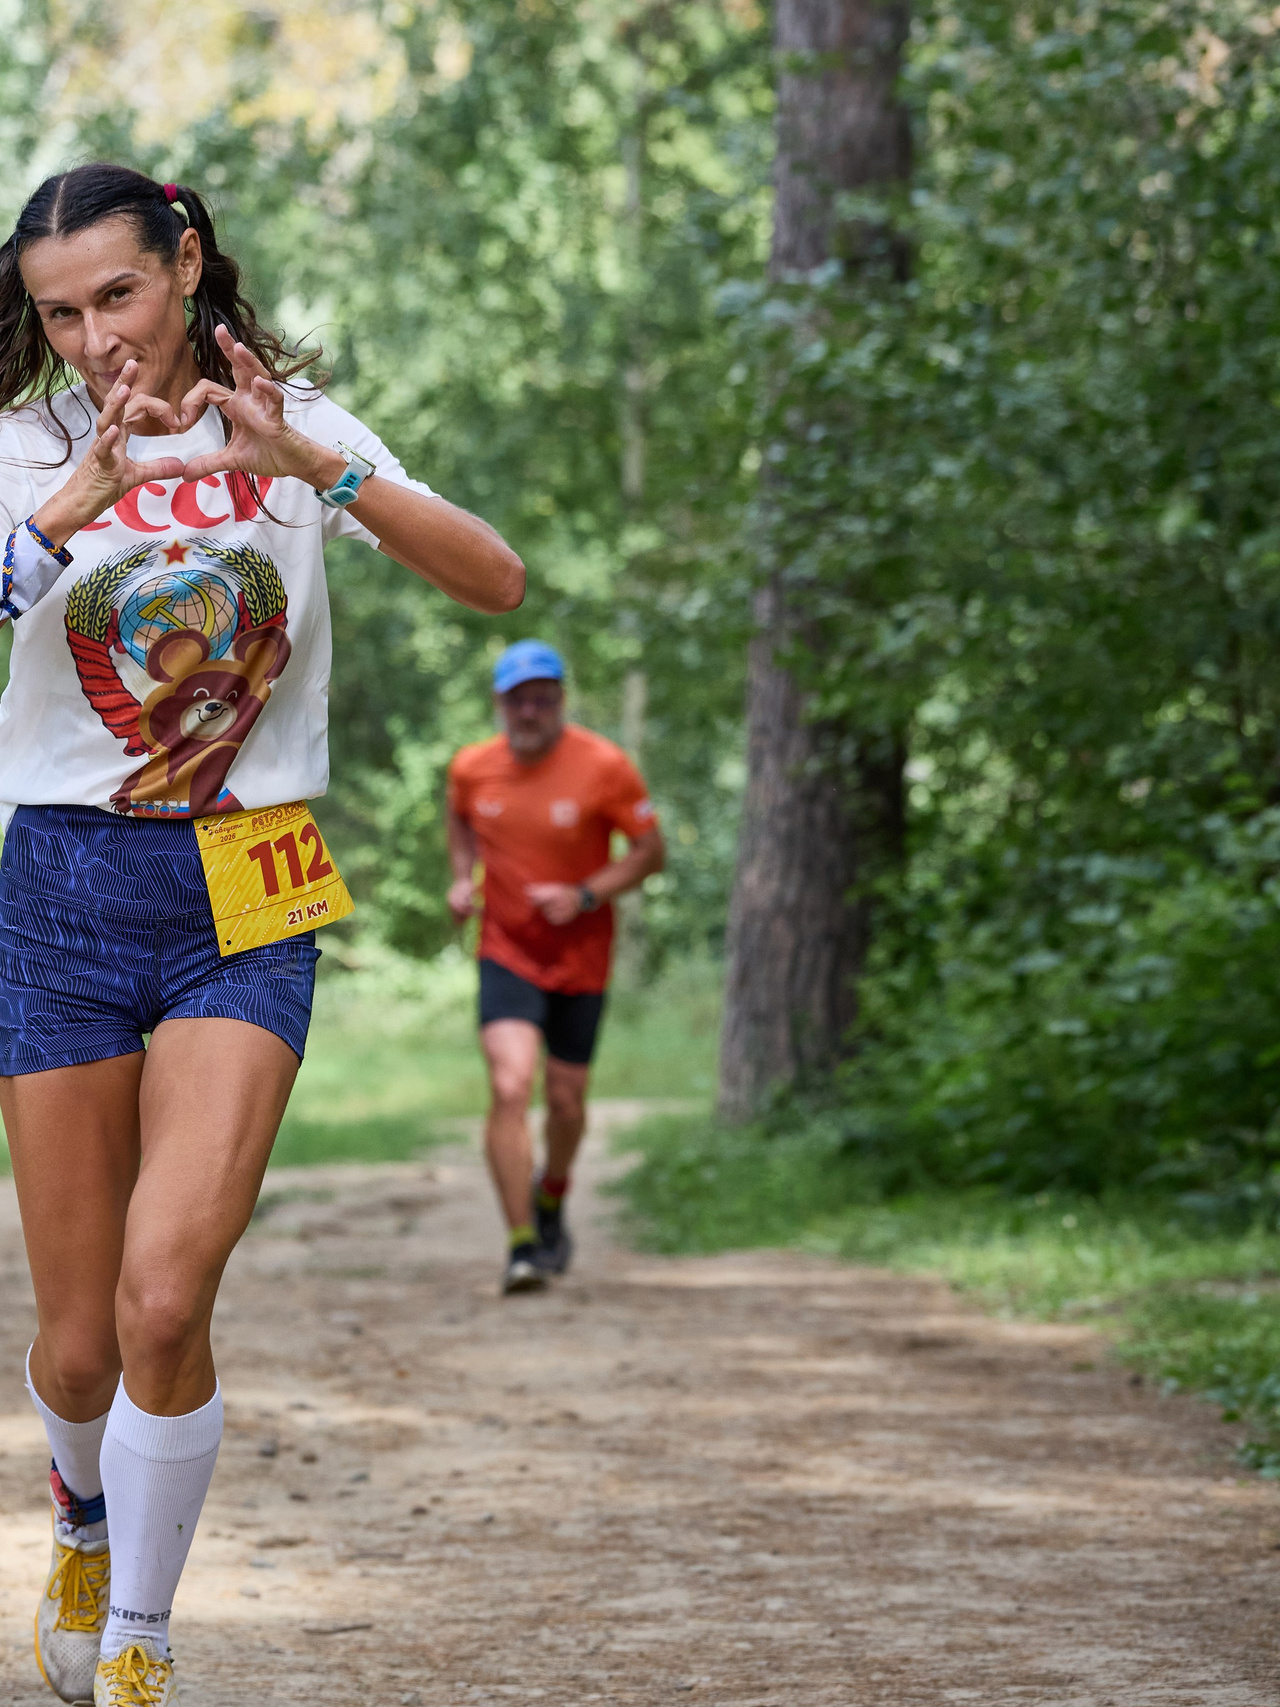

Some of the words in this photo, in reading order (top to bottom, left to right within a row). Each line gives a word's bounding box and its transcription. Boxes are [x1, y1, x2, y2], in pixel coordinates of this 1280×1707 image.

[251, 808, 283, 828] РЕТРО
[247, 822, 333, 897] 112
[287, 908, 304, 925] 21
